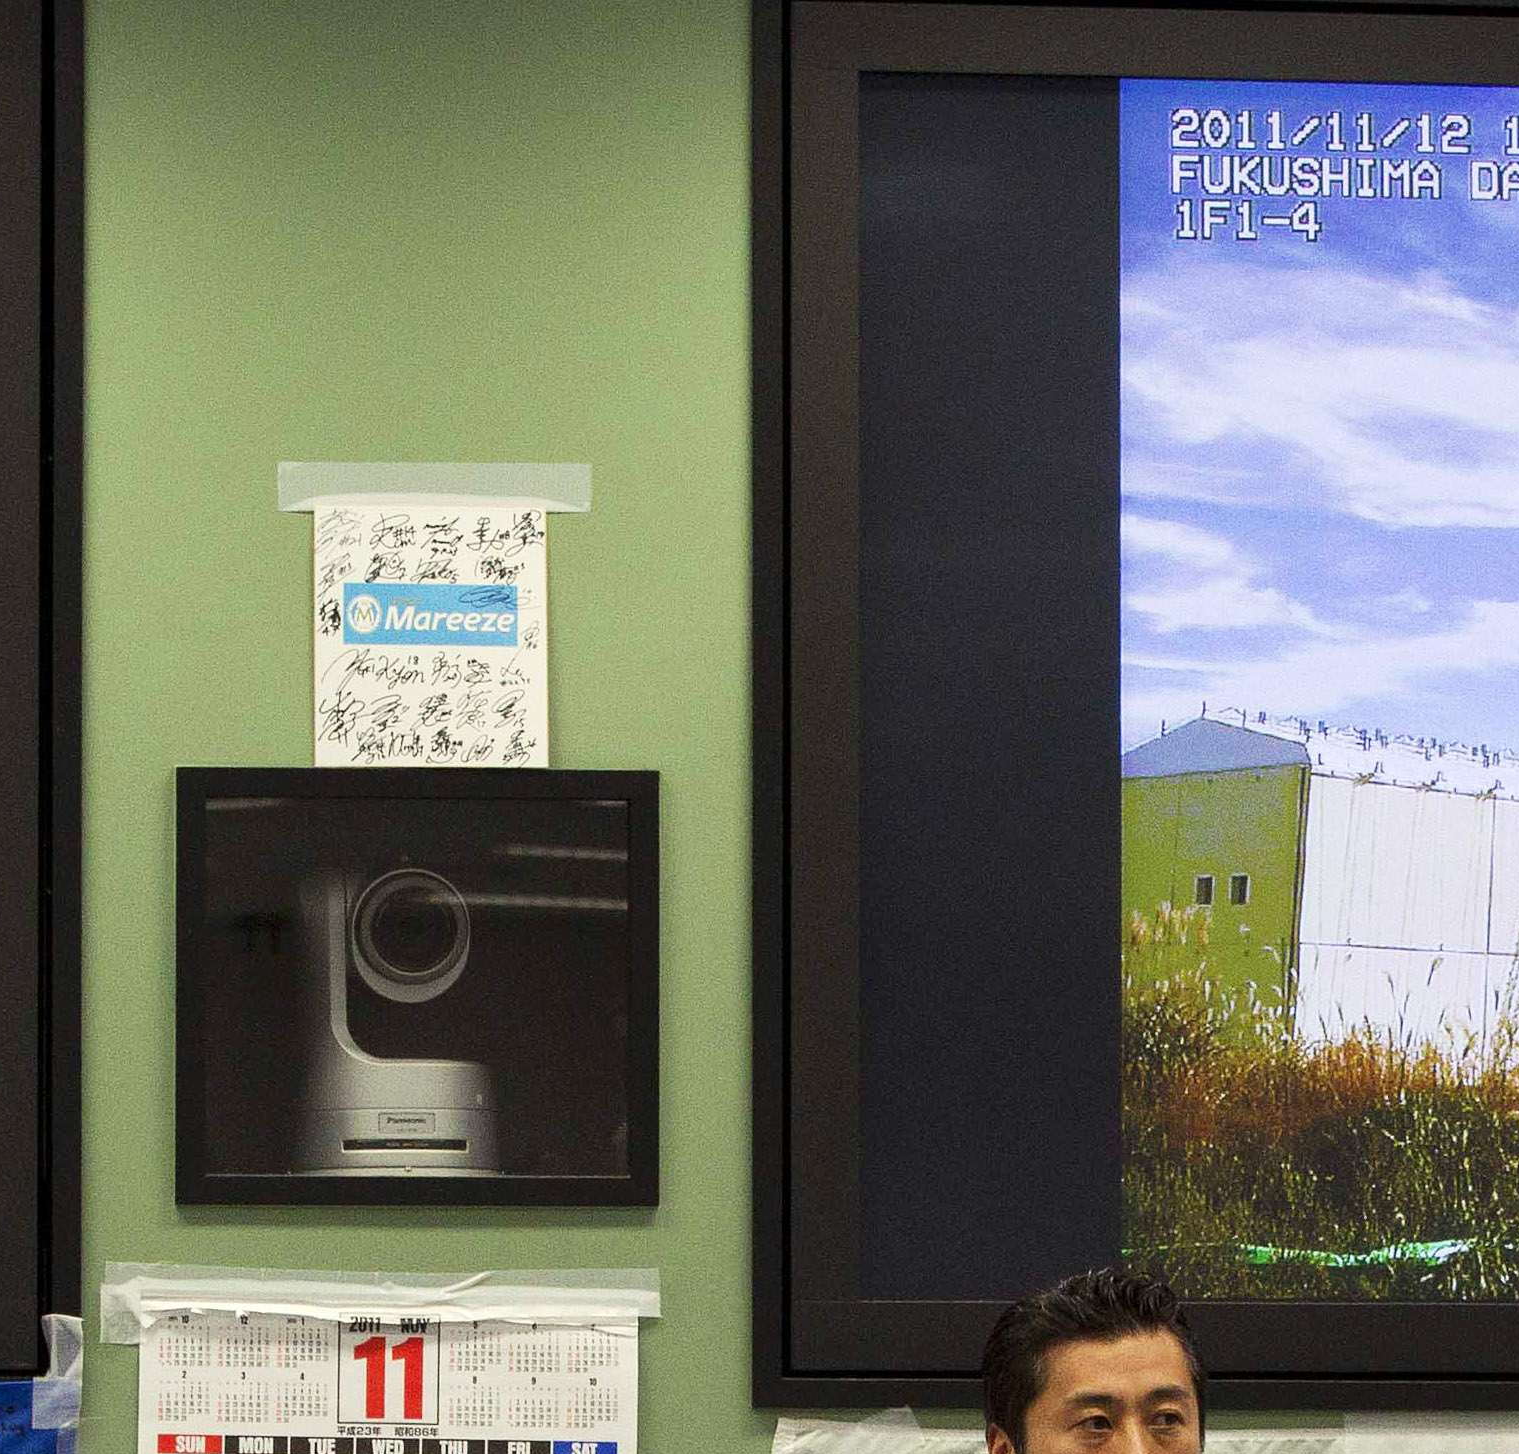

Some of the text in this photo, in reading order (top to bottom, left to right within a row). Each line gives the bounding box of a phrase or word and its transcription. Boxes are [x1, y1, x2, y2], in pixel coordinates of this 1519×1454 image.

[1170, 108, 1471, 156] 2011/11/12
[1170, 154, 1442, 200] FUKUSHIMA
[1174, 199, 1323, 243] 1F1-4
[383, 601, 516, 634] Mareeze
[354, 1336, 424, 1420] 11
[175, 1436, 205, 1453] SUN
[239, 1437, 273, 1454] MON
[308, 1438, 335, 1454] TUE
